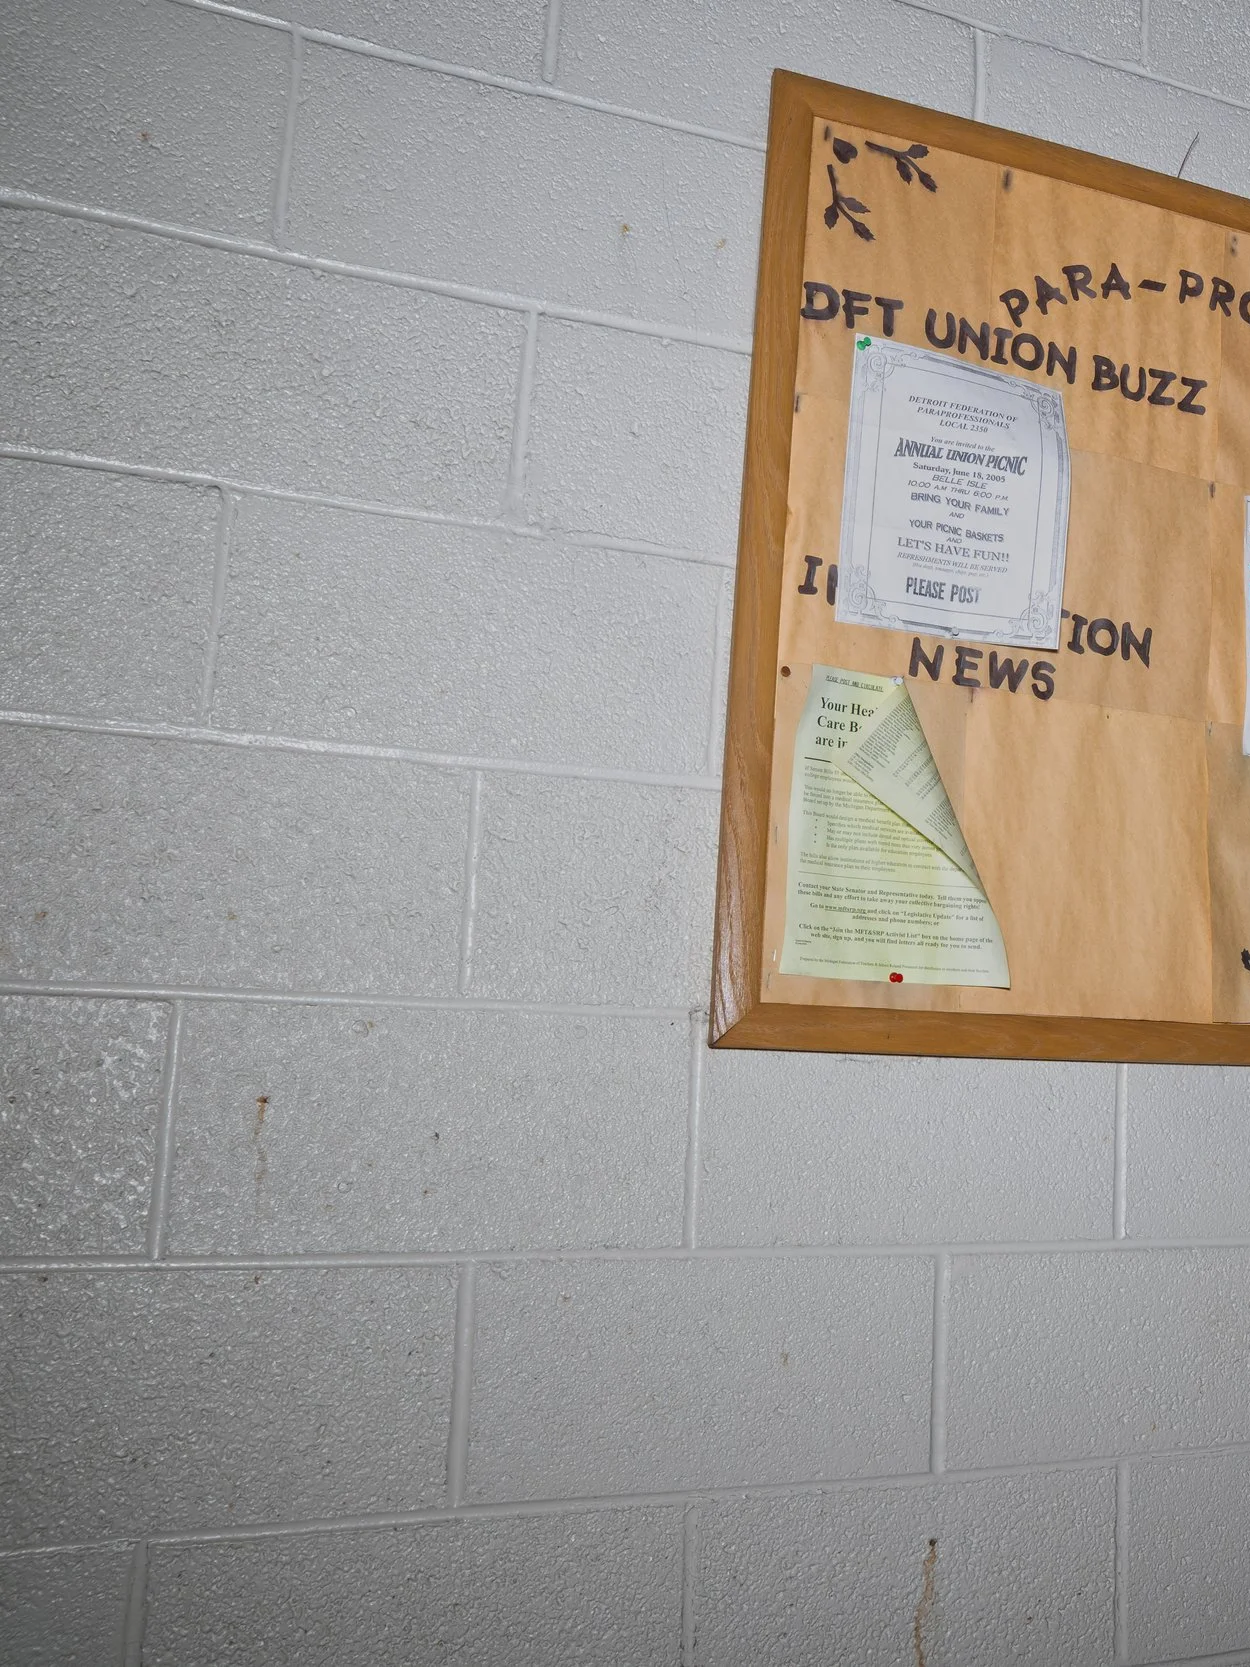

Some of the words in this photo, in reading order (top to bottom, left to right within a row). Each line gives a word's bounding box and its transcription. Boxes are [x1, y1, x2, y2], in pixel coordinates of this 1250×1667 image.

[800, 281, 904, 337] DFT
[924, 308, 1077, 384] UNION
[1090, 355, 1208, 416] BUZZ
[909, 395, 947, 408] DETROIT
[950, 399, 1004, 419] FEDERATION
[1006, 414, 1019, 423] OF
[917, 406, 1010, 429] PARAPROFESSIONALS
[940, 420, 968, 430] LOCAL
[970, 425, 988, 433] 2350
[931, 436, 942, 444] You
[956, 440, 976, 449] invited
[985, 444, 996, 452] the
[894, 437, 944, 459] ANNUAL
[946, 449, 986, 466] UNION
[985, 454, 1028, 476] PICNIC
[913, 462, 951, 475] Saturday,
[953, 467, 970, 477] June
[973, 471, 984, 480] 18,
[986, 474, 1005, 483] 2005
[932, 474, 964, 486] BELLE
[967, 479, 988, 490] ISLE
[951, 487, 970, 495] THRU
[973, 490, 992, 499] 6:00
[910, 492, 941, 504] BRING
[945, 497, 972, 511] YOUR
[975, 504, 1010, 516] FAMILY
[949, 511, 964, 519] AND
[909, 519, 933, 529] YOUR
[936, 522, 962, 536] PICNIC
[965, 529, 1004, 543] BASKETS
[897, 536, 932, 551] LET'S
[935, 543, 970, 558] HAVE
[973, 550, 1010, 562] FUN!!
[897, 551, 951, 567] REFRESHMENTS
[952, 560, 969, 569] WILL
[980, 564, 1008, 574] SERVED
[906, 576, 946, 600] PLEASE
[950, 584, 982, 604] POST
[908, 636, 1055, 700] NEWS
[820, 696, 848, 713] Your
[817, 715, 846, 731] Care
[815, 735, 834, 747] are
[798, 881, 819, 890] Contact
[878, 889, 918, 899] Representative
[933, 901, 962, 910] bargaining
